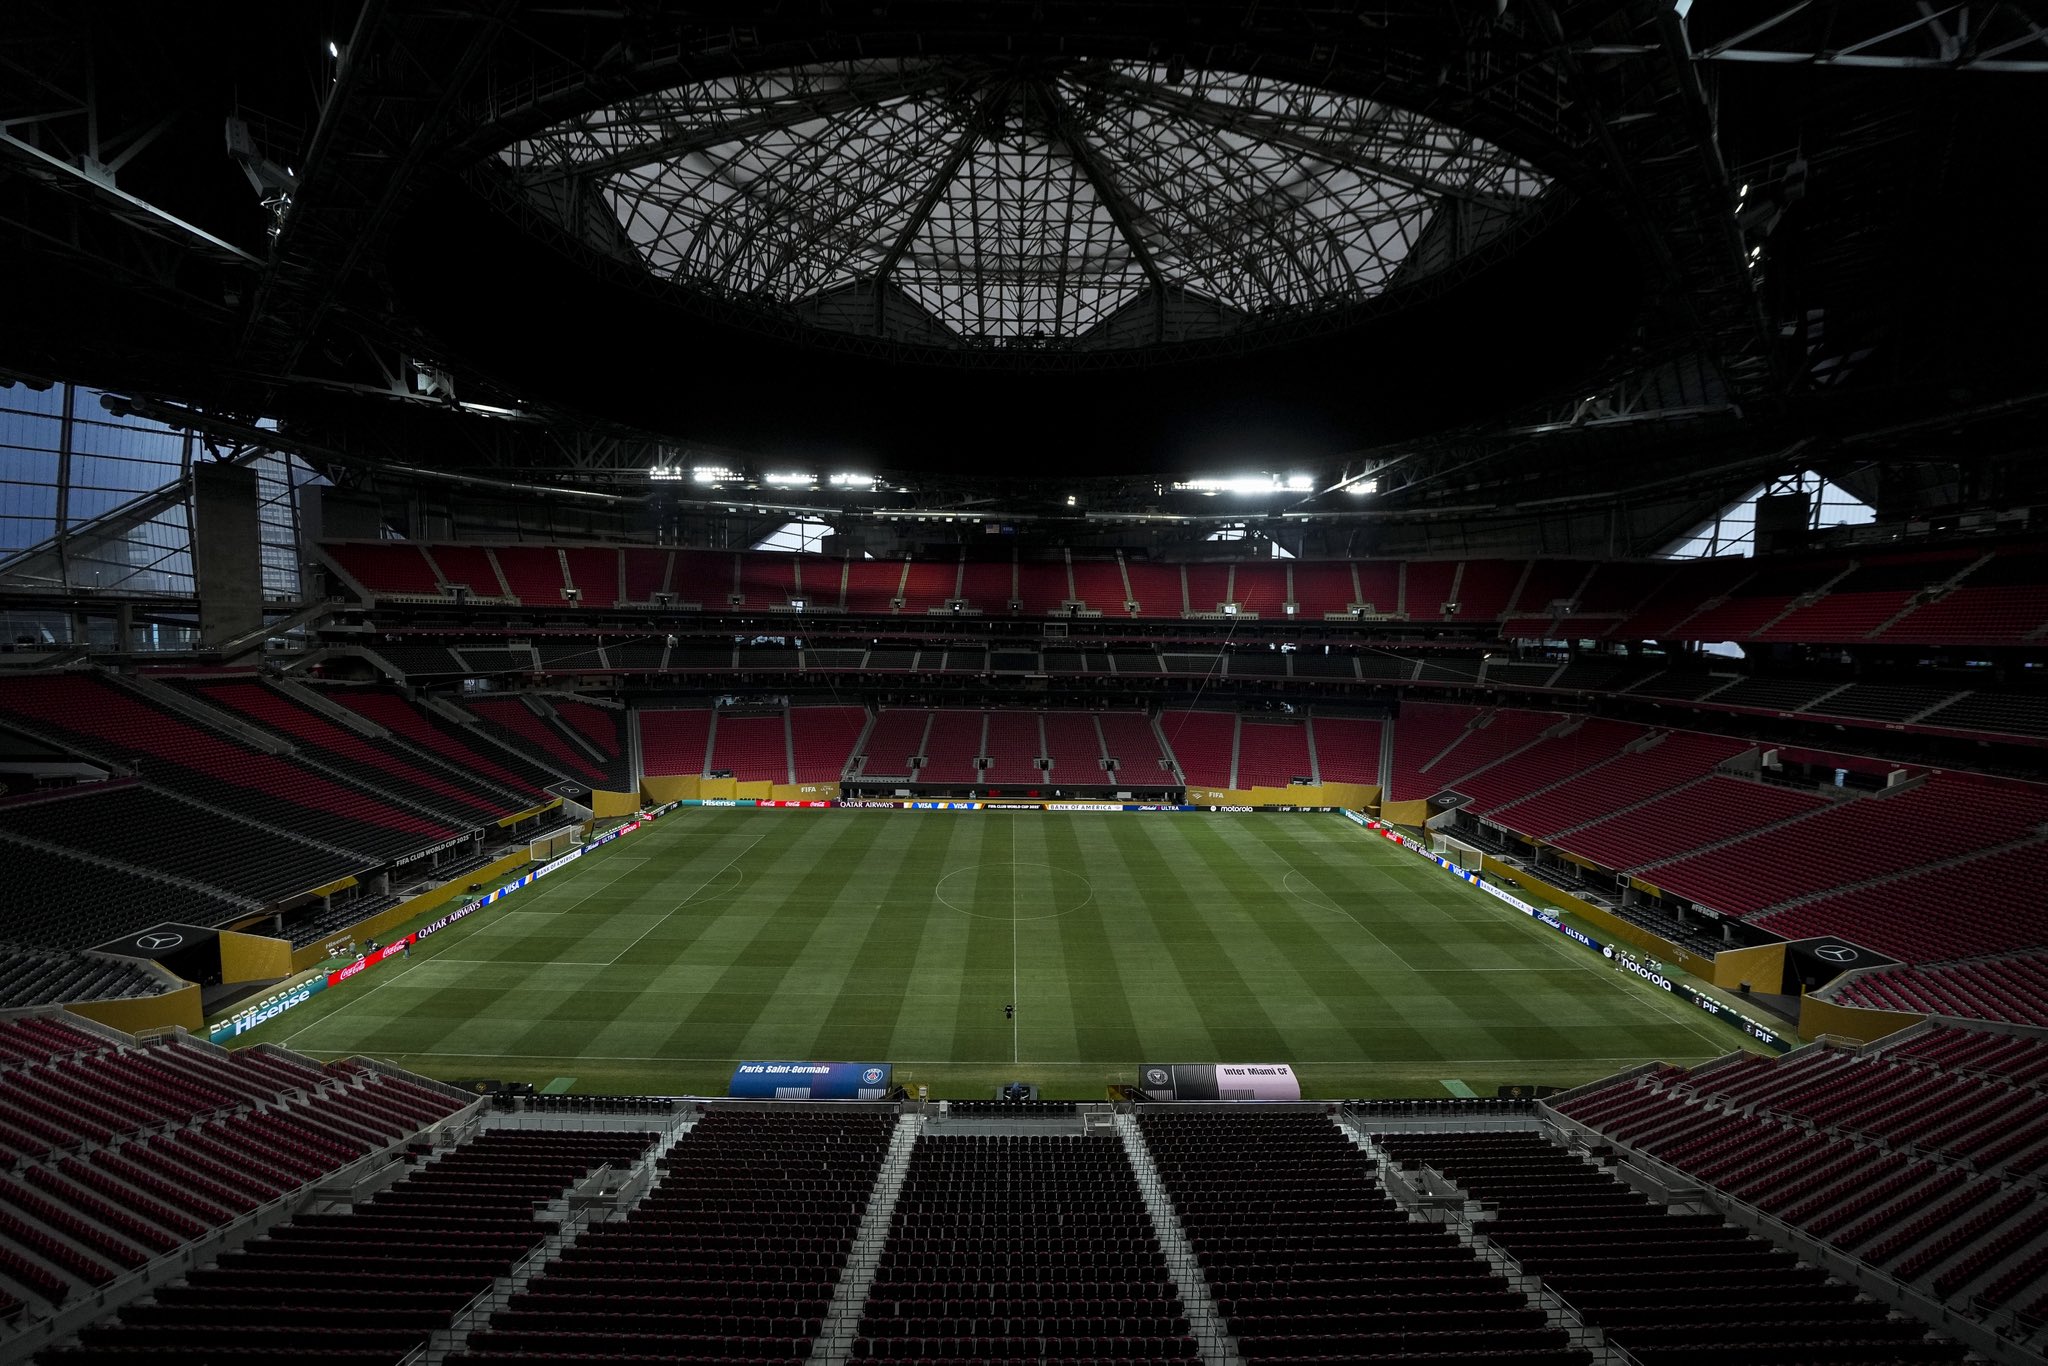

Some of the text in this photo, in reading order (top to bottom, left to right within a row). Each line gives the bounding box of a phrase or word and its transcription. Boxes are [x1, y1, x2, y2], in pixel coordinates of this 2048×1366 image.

[620, 824, 637, 836] Lenovo
[602, 834, 616, 844] ULTRA
[396, 857, 410, 867] FIFA
[410, 851, 425, 862] CLUB
[425, 844, 446, 856] WORLD
[446, 840, 456, 848] CUP
[537, 867, 550, 876] BANK
[556, 854, 575, 866] AMERICA
[1453, 865, 1465, 879] VISA
[504, 881, 520, 895] VISA
[1501, 893, 1525, 909] AMERICA
[418, 901, 481, 939] QATAR AIRWAYS
[1565, 926, 1590, 946] ULTRA
[382, 938, 407, 958] Coca-Cola
[340, 959, 366, 980] Coca-Cola
[235, 990, 310, 1036] Hisense
[1702, 1000, 1719, 1014] PIF
[1755, 1029, 1774, 1044] PIF
[739, 1065, 830, 1074] Paris Saint-Germain
[1223, 1067, 1288, 1076] Inter Miami CF
